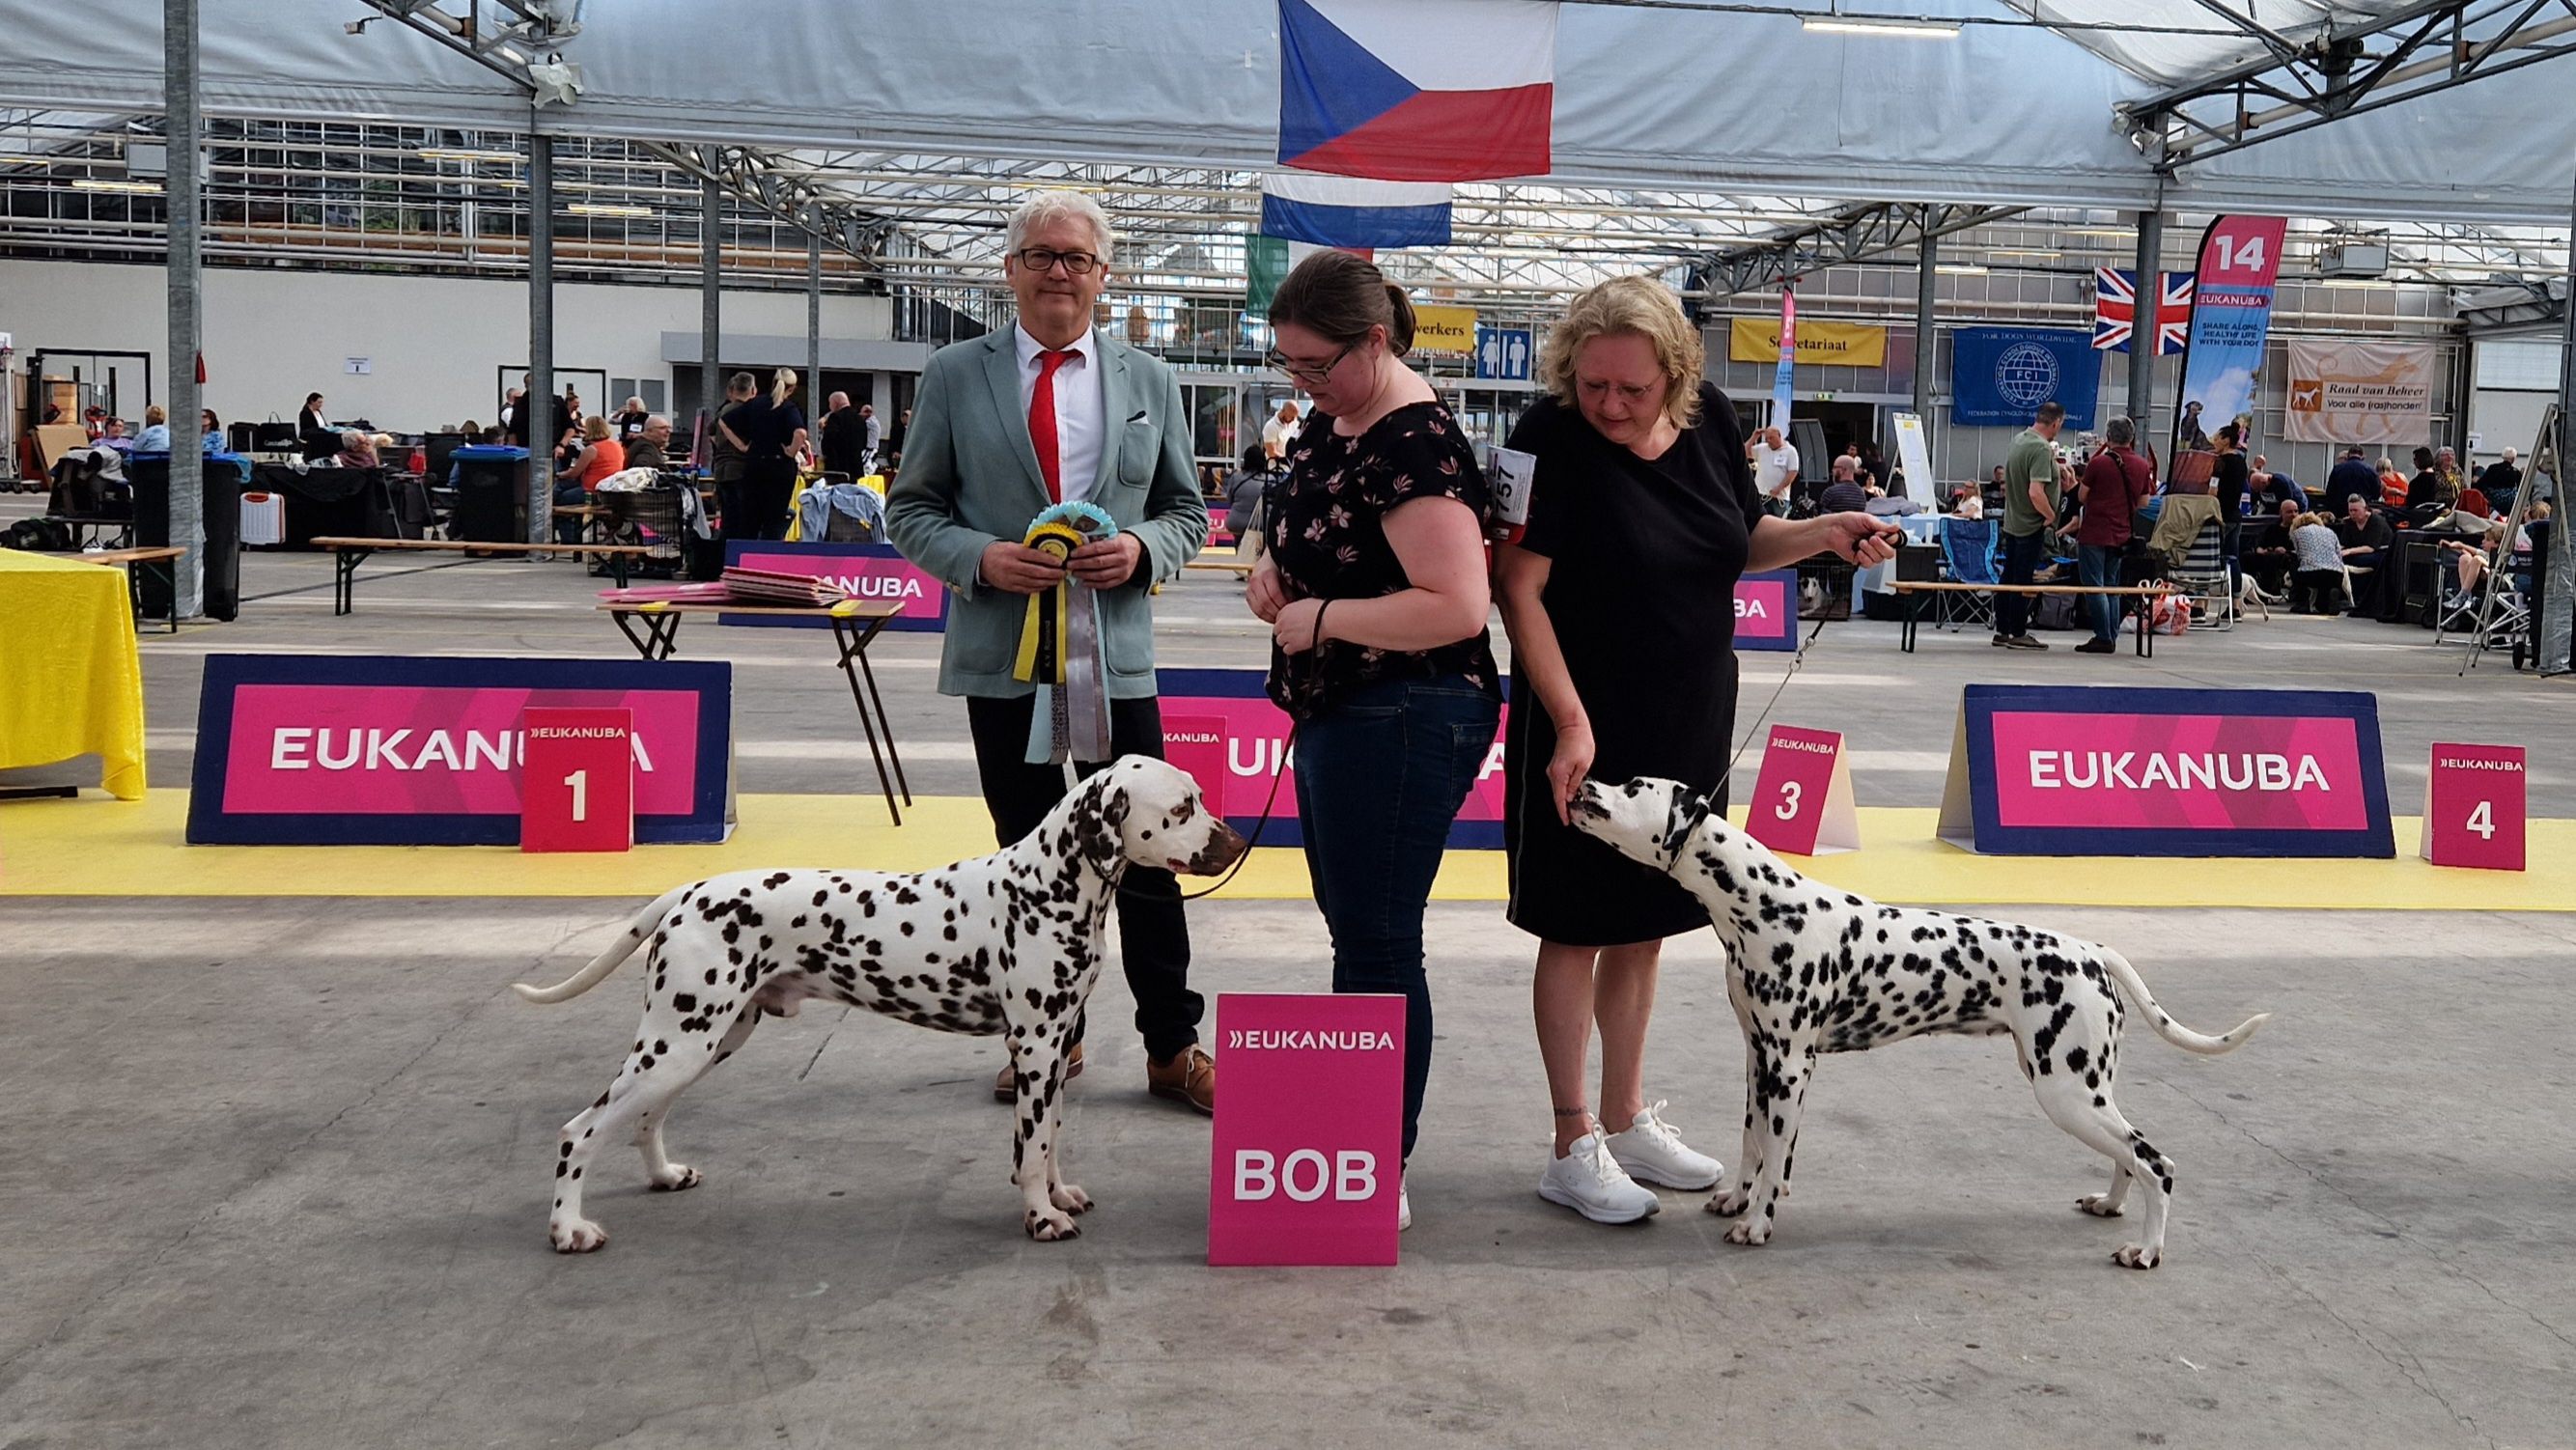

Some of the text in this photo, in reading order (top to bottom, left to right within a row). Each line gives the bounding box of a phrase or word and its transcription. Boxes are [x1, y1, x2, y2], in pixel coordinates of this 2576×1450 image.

[2215, 236, 2264, 271] 14
[2201, 294, 2262, 305] EUKANUBA
[1769, 335, 1846, 351] Seetariaat
[2017, 370, 2038, 380] FCI
[2329, 383, 2359, 394] Raad
[2387, 385, 2424, 396] Beheer
[2327, 400, 2347, 408] Voor
[1496, 465, 1514, 513] 757
[540, 727, 626, 739] EUKANUBA
[1162, 733, 1219, 743] KANUBA
[1778, 739, 1834, 754] EUKANUBA
[2030, 750, 2331, 791] EUKANUBA
[2448, 759, 2523, 771] EUKANUBA
[564, 769, 586, 822] 1
[1775, 780, 1802, 821] 3
[2466, 800, 2496, 840] 4
[1246, 1030, 1395, 1050] EUKANUBA
[1234, 1149, 1377, 1202] BOB
